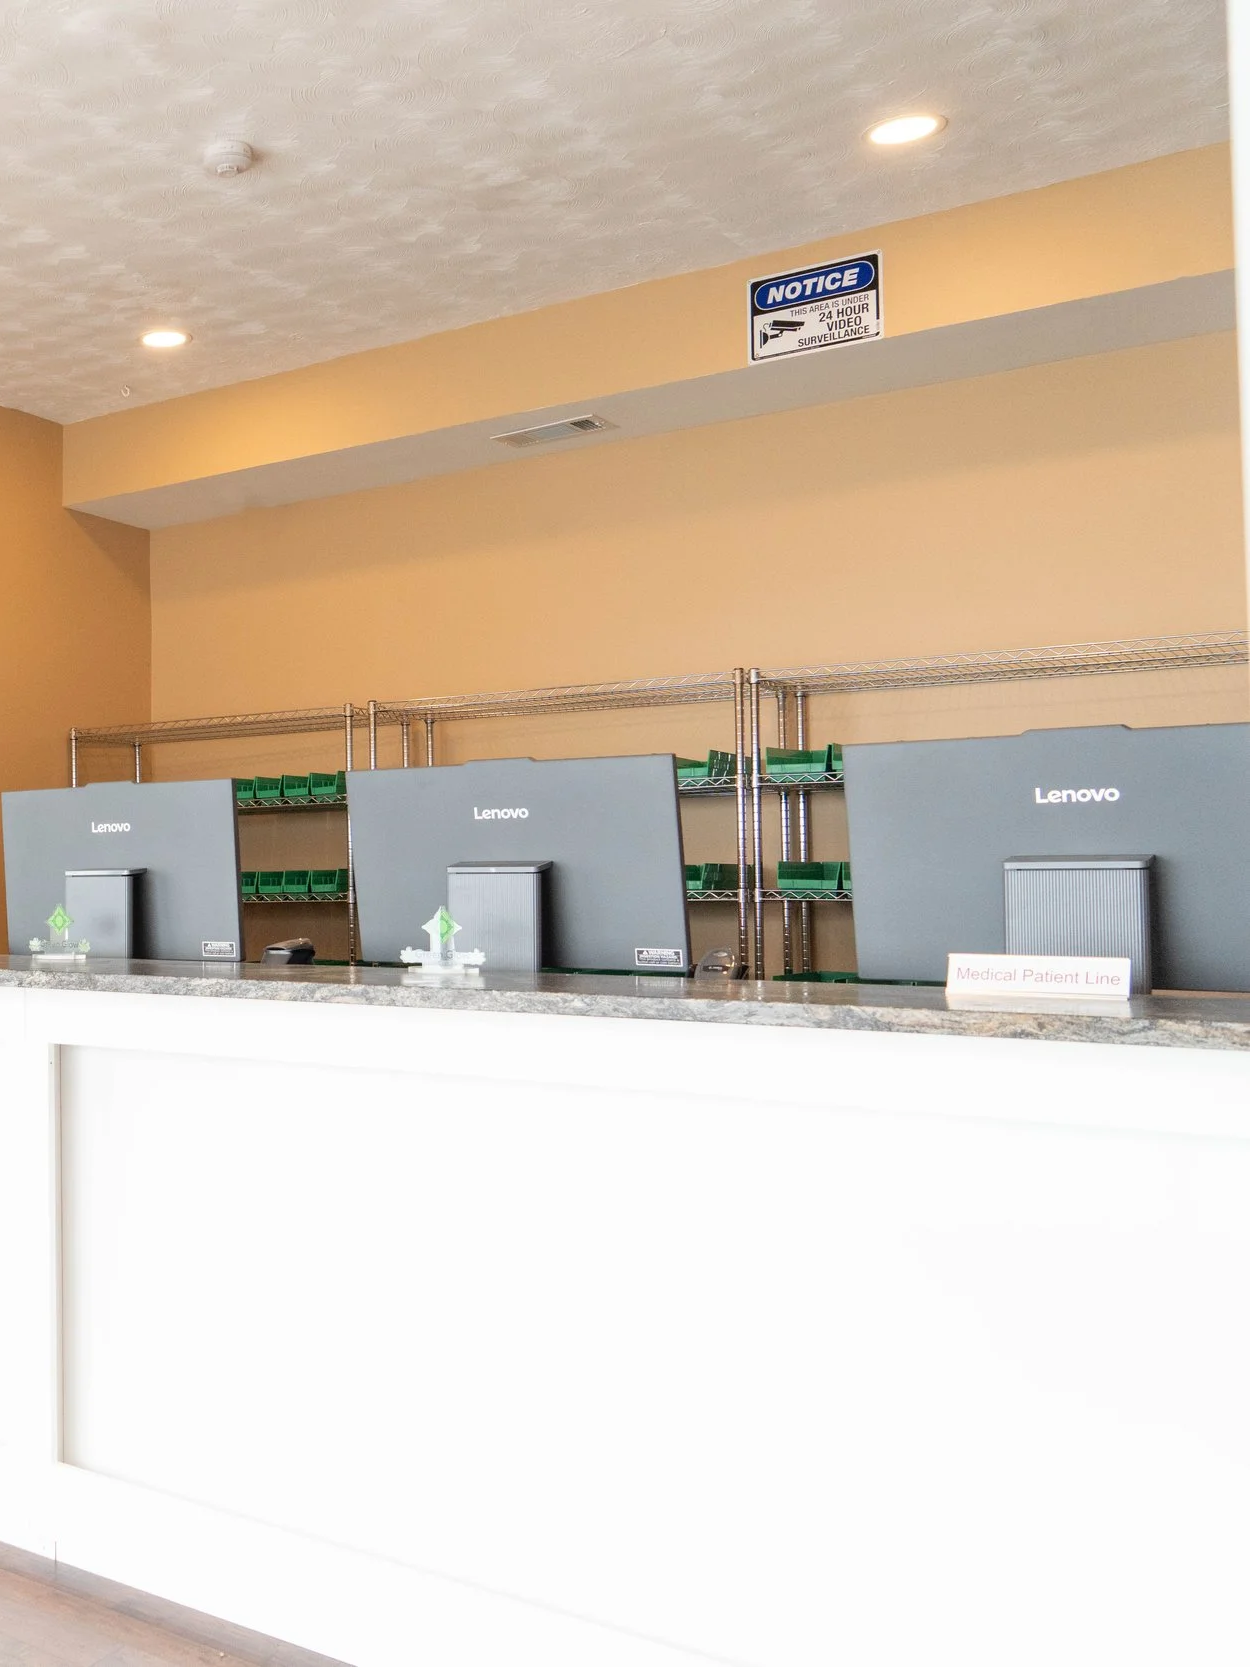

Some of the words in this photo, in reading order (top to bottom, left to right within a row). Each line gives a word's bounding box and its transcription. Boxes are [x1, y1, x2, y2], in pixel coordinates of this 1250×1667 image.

[767, 267, 860, 304] NOTICE
[790, 308, 808, 317] THIS
[809, 302, 830, 313] AREA
[832, 299, 840, 308] IS
[841, 293, 870, 306] UNDER
[818, 310, 833, 323] 24
[836, 302, 870, 318] HOUR
[826, 315, 862, 332] VIDEO
[797, 324, 870, 347] SURVEILLANCE
[1035, 787, 1120, 804] Lenovo
[473, 806, 529, 820] Lenovo
[91, 821, 131, 833] Lenovo
[956, 967, 1017, 982] Medical
[1022, 969, 1079, 984] Patient
[1085, 971, 1121, 985] Line
